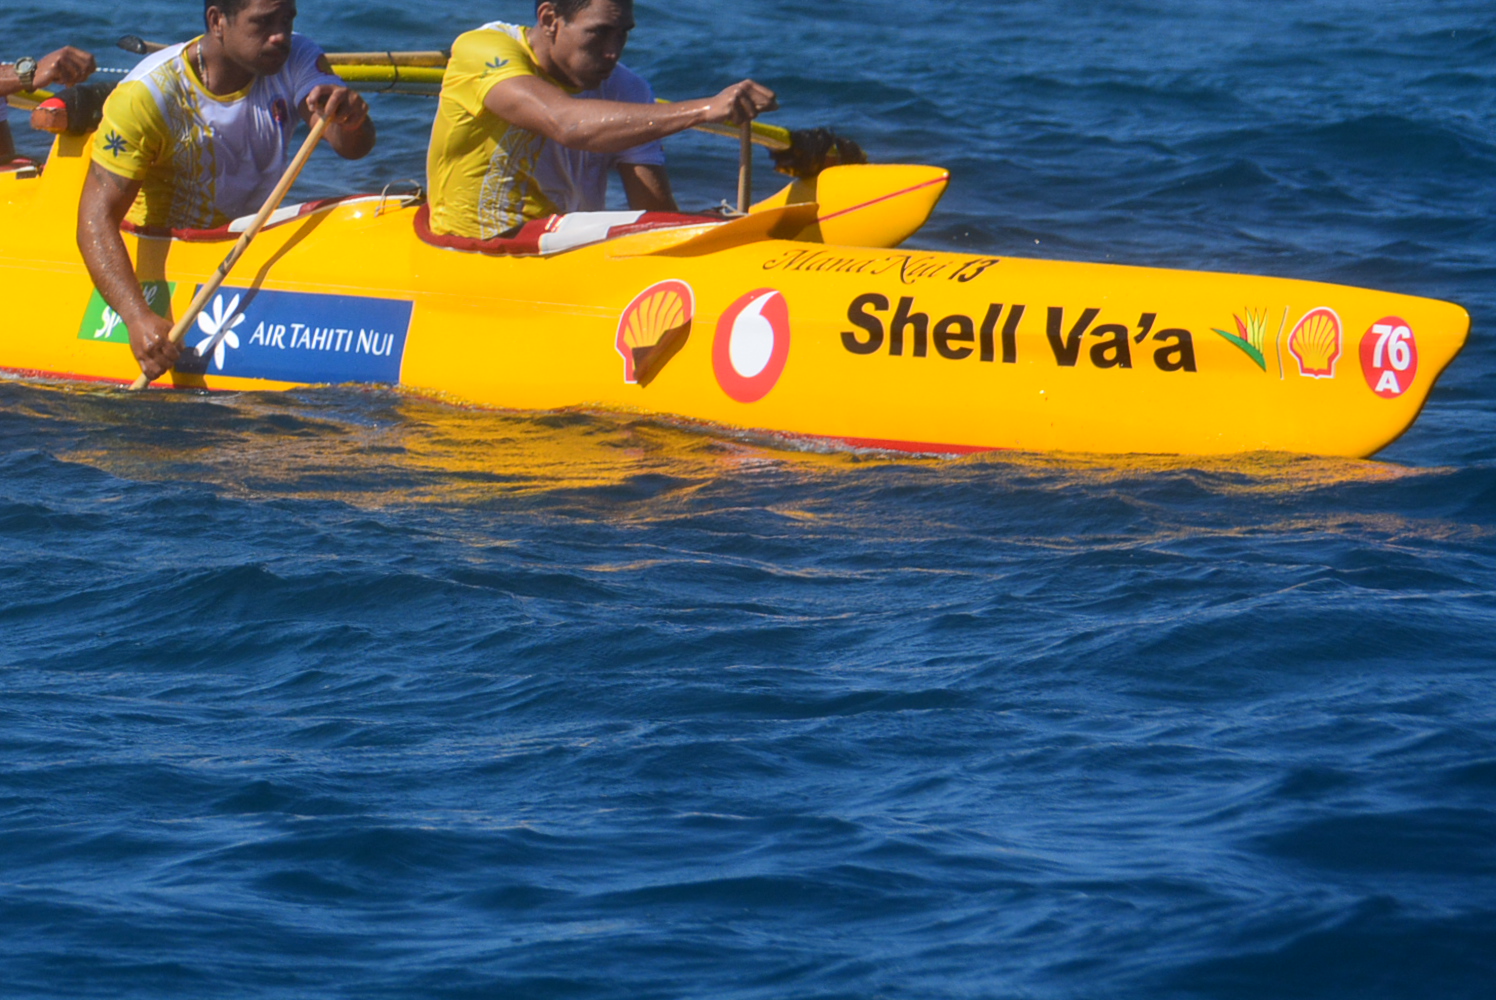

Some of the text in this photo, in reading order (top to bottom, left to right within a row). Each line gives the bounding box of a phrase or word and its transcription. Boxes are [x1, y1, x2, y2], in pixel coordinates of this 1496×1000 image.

[762, 249, 1000, 285] Mana Nui 13
[248, 321, 394, 356] AIR TAHITI NUI
[840, 292, 1197, 373] Shell Va'a
[1371, 324, 1411, 371] 76
[1374, 371, 1401, 393] A
